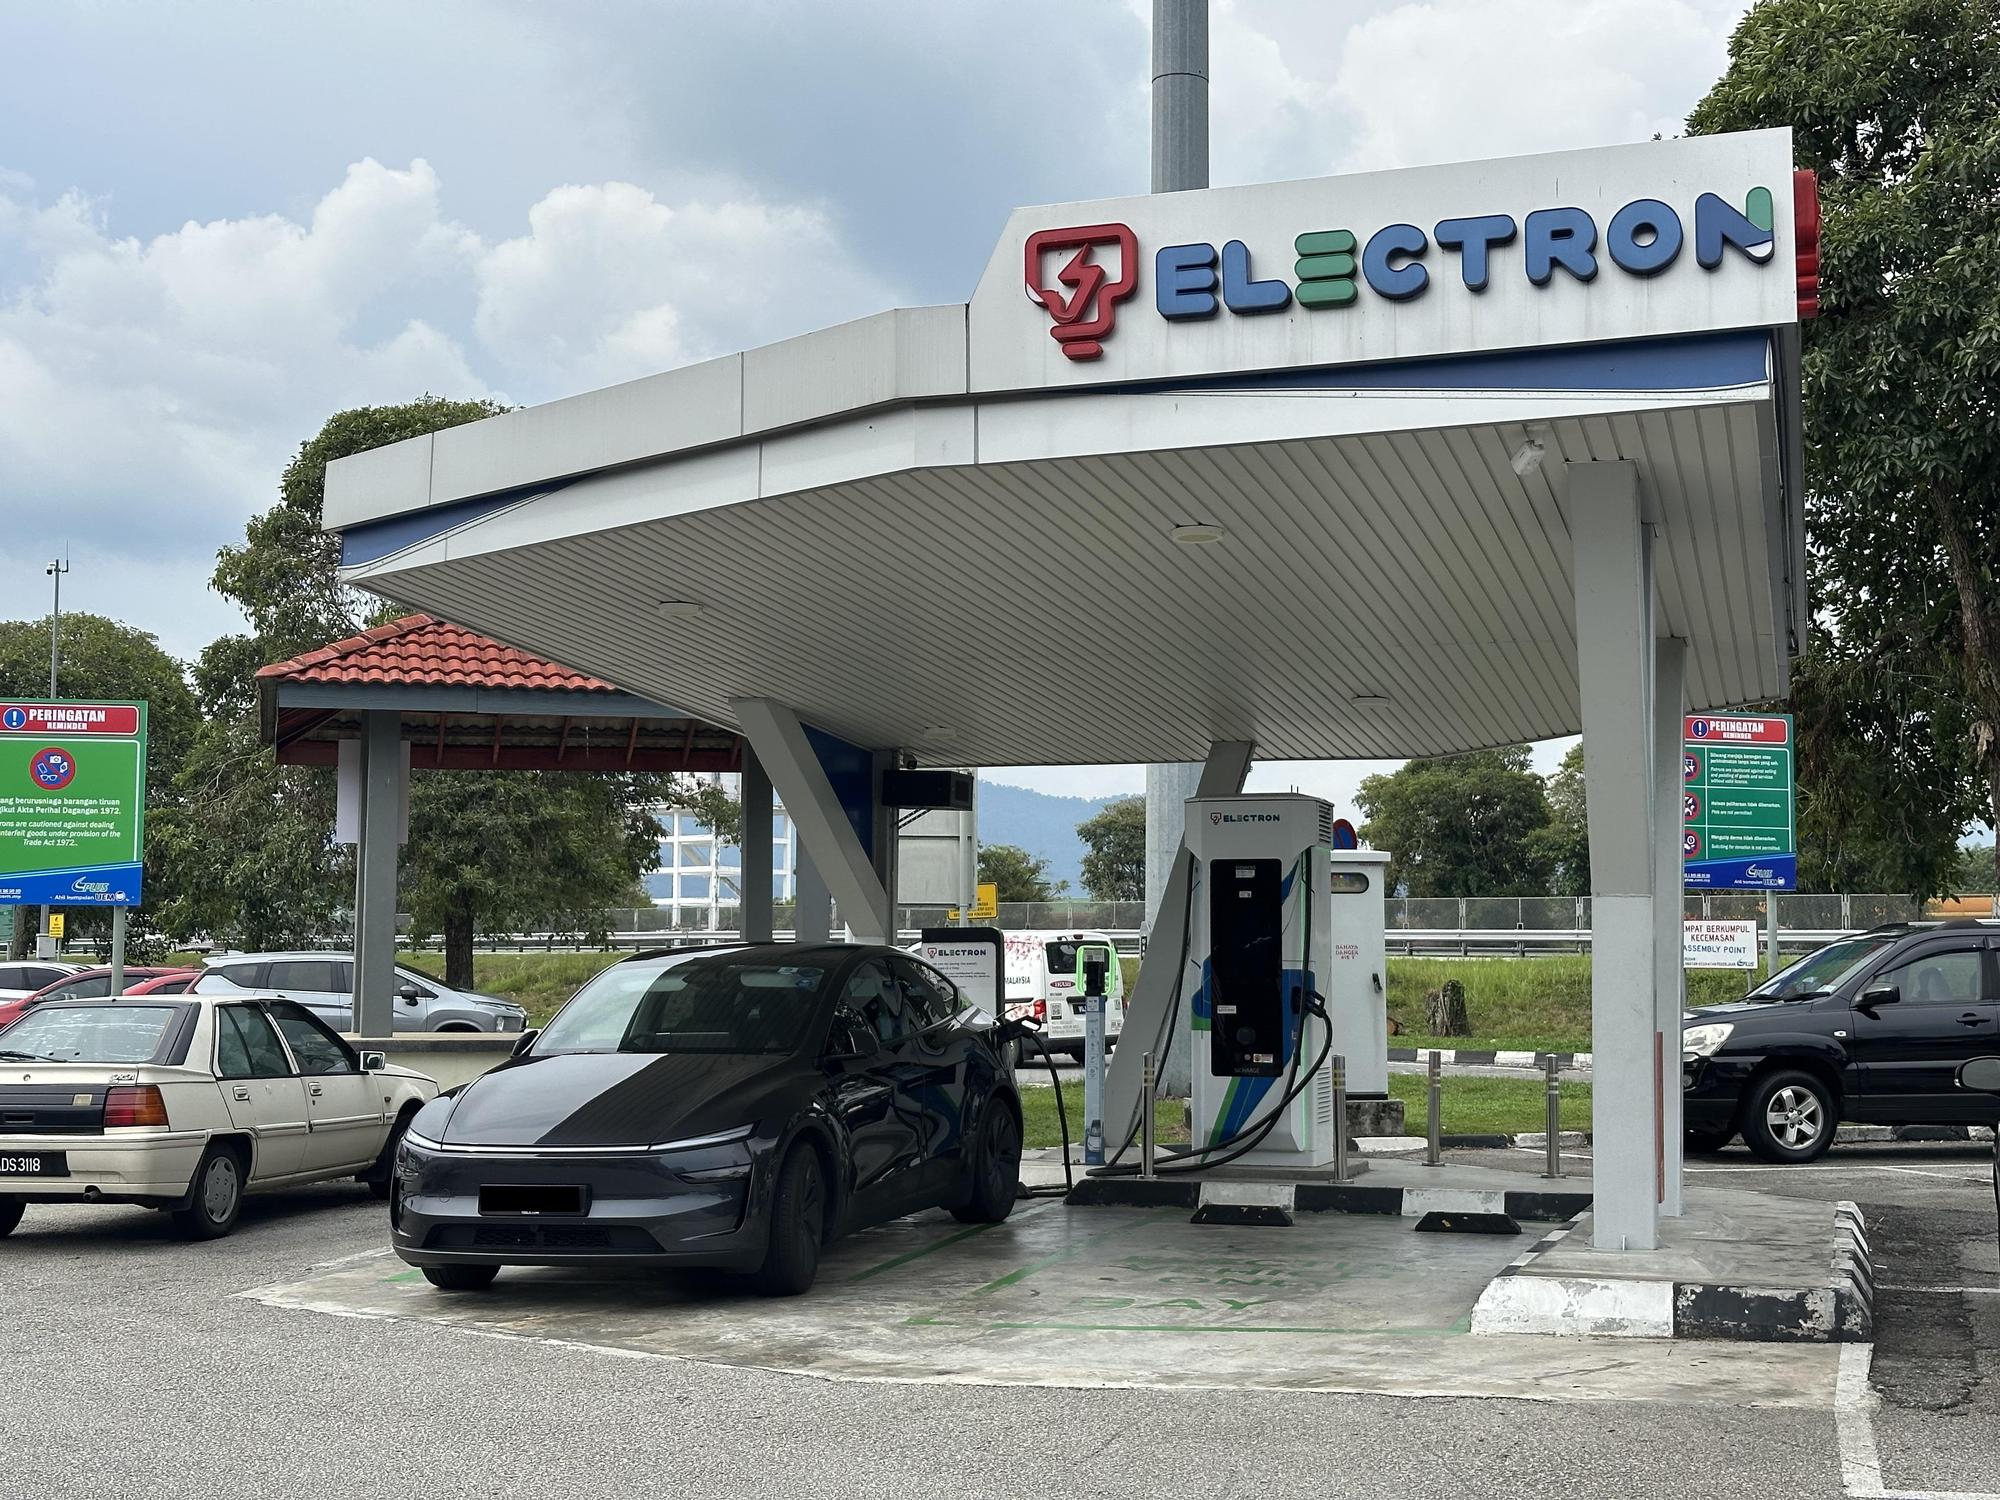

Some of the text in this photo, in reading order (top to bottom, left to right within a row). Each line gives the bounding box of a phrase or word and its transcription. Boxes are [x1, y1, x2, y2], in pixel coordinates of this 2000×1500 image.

[1155, 185, 1776, 322] ELECTRON
[28, 708, 106, 722] PERINGATAN
[46, 722, 88, 730] REMINDER
[1710, 720, 1764, 733] PERINGATAN
[64, 798, 98, 806] barangan
[62, 807, 98, 815] Dagangan
[1691, 934, 1735, 942] KECEMASAN
[0, 1158, 41, 1172] DS3118
